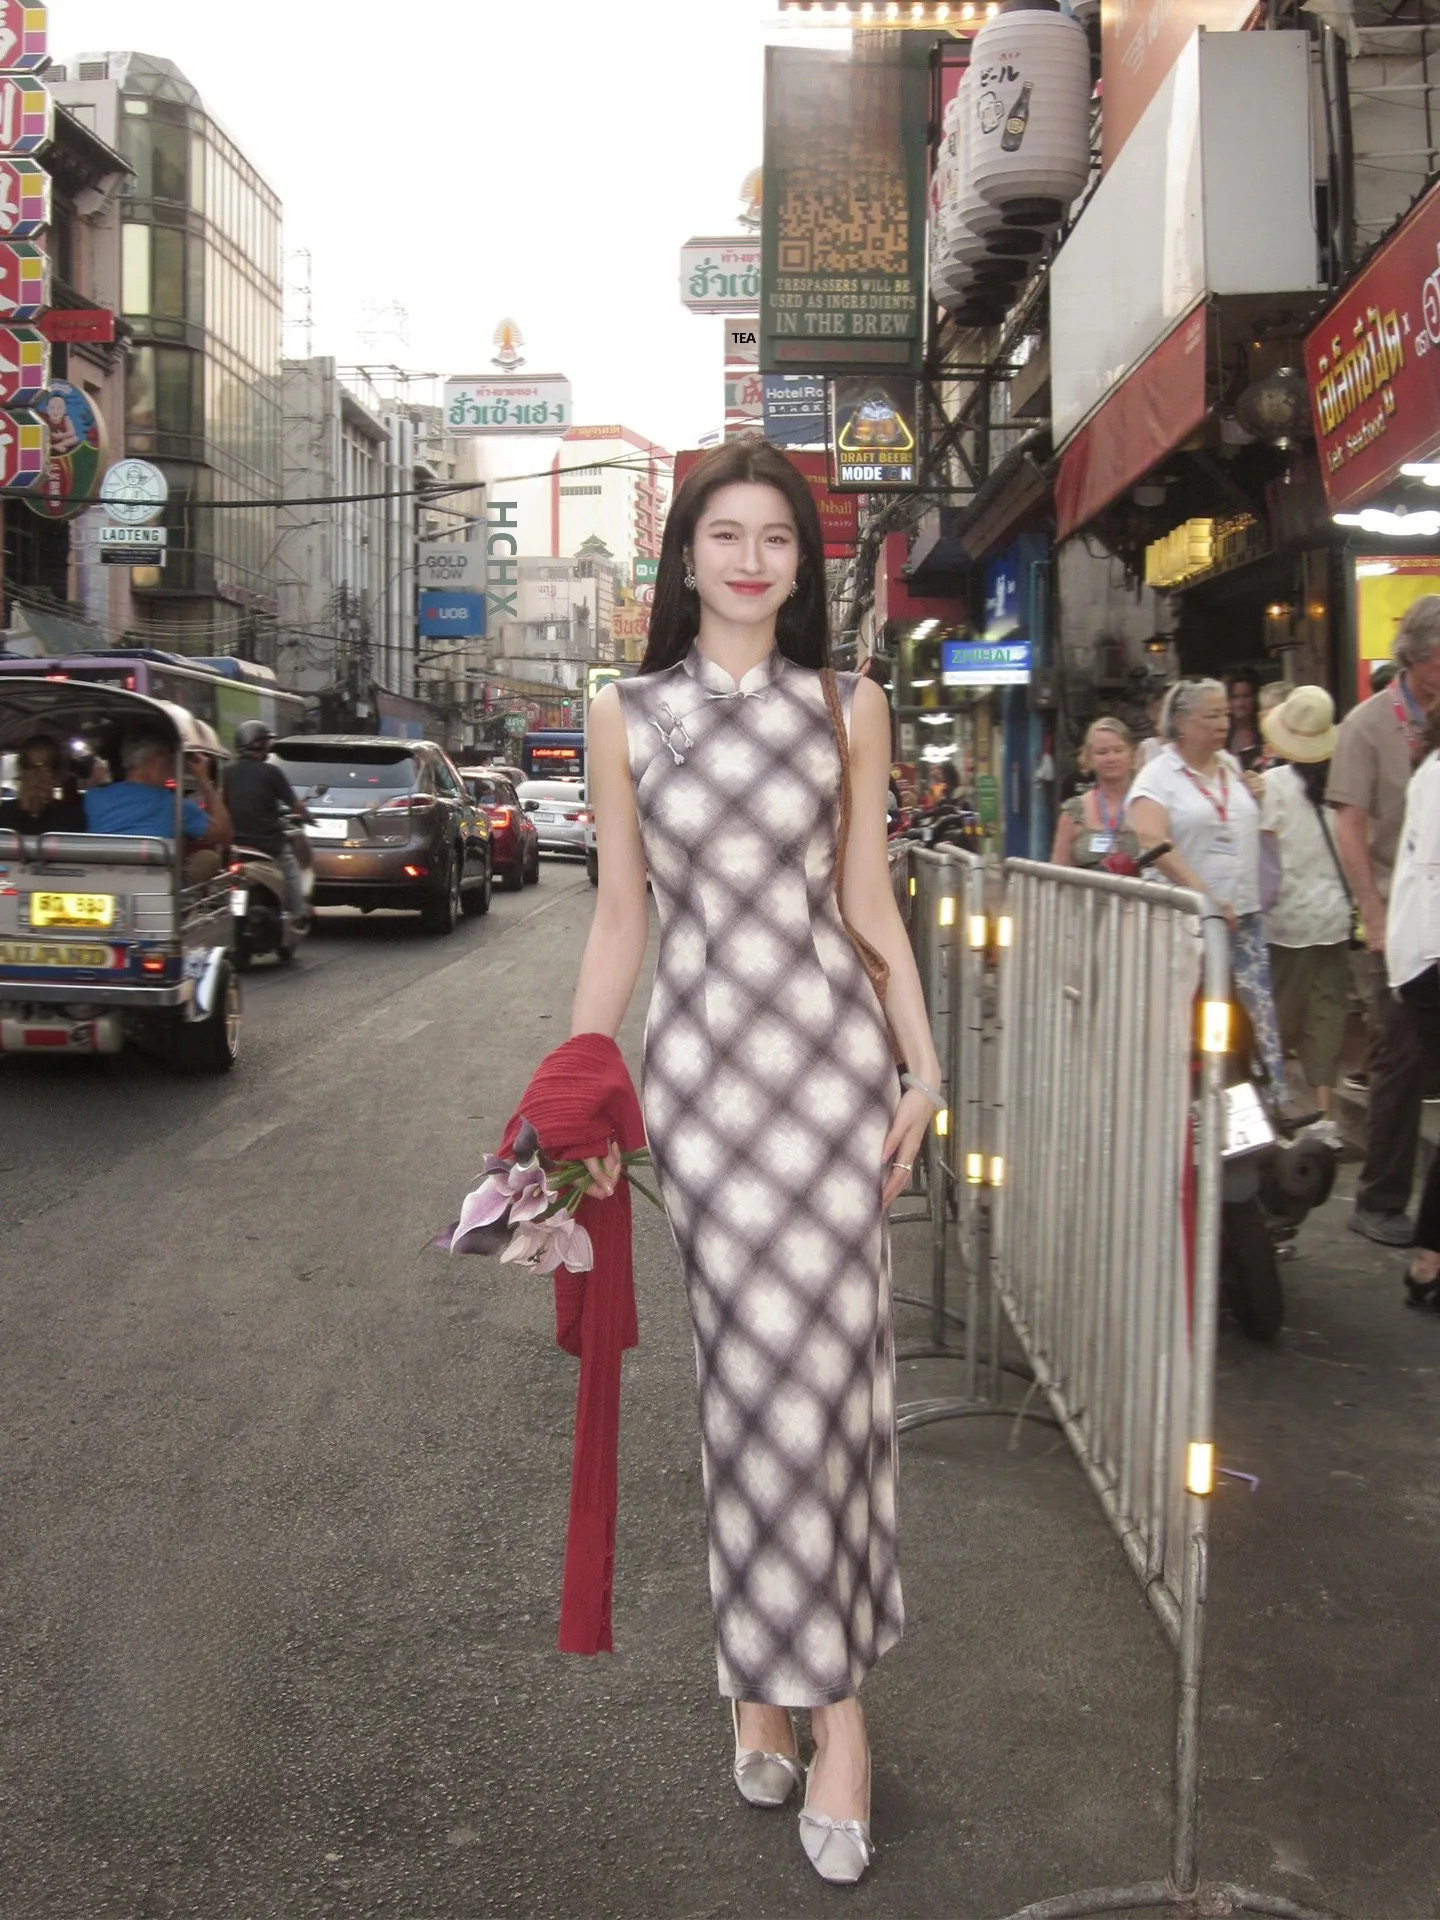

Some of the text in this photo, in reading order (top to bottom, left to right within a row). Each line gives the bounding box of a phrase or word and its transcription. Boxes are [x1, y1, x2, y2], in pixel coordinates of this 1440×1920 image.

[981, 65, 1020, 87] ビール
[777, 278, 910, 292] TRESPASSERS WILL BE
[769, 294, 917, 309] USED AS INGREDIENTS
[776, 313, 909, 334] IN THE BREW
[732, 332, 757, 344] TEA
[766, 387, 803, 399] Hotel
[841, 452, 876, 463] DRAFT
[842, 466, 883, 480] MODE
[102, 529, 160, 541] LAOTENG
[425, 556, 468, 568] GOLD
[430, 567, 464, 579] NOW
[439, 607, 468, 619] UOB
